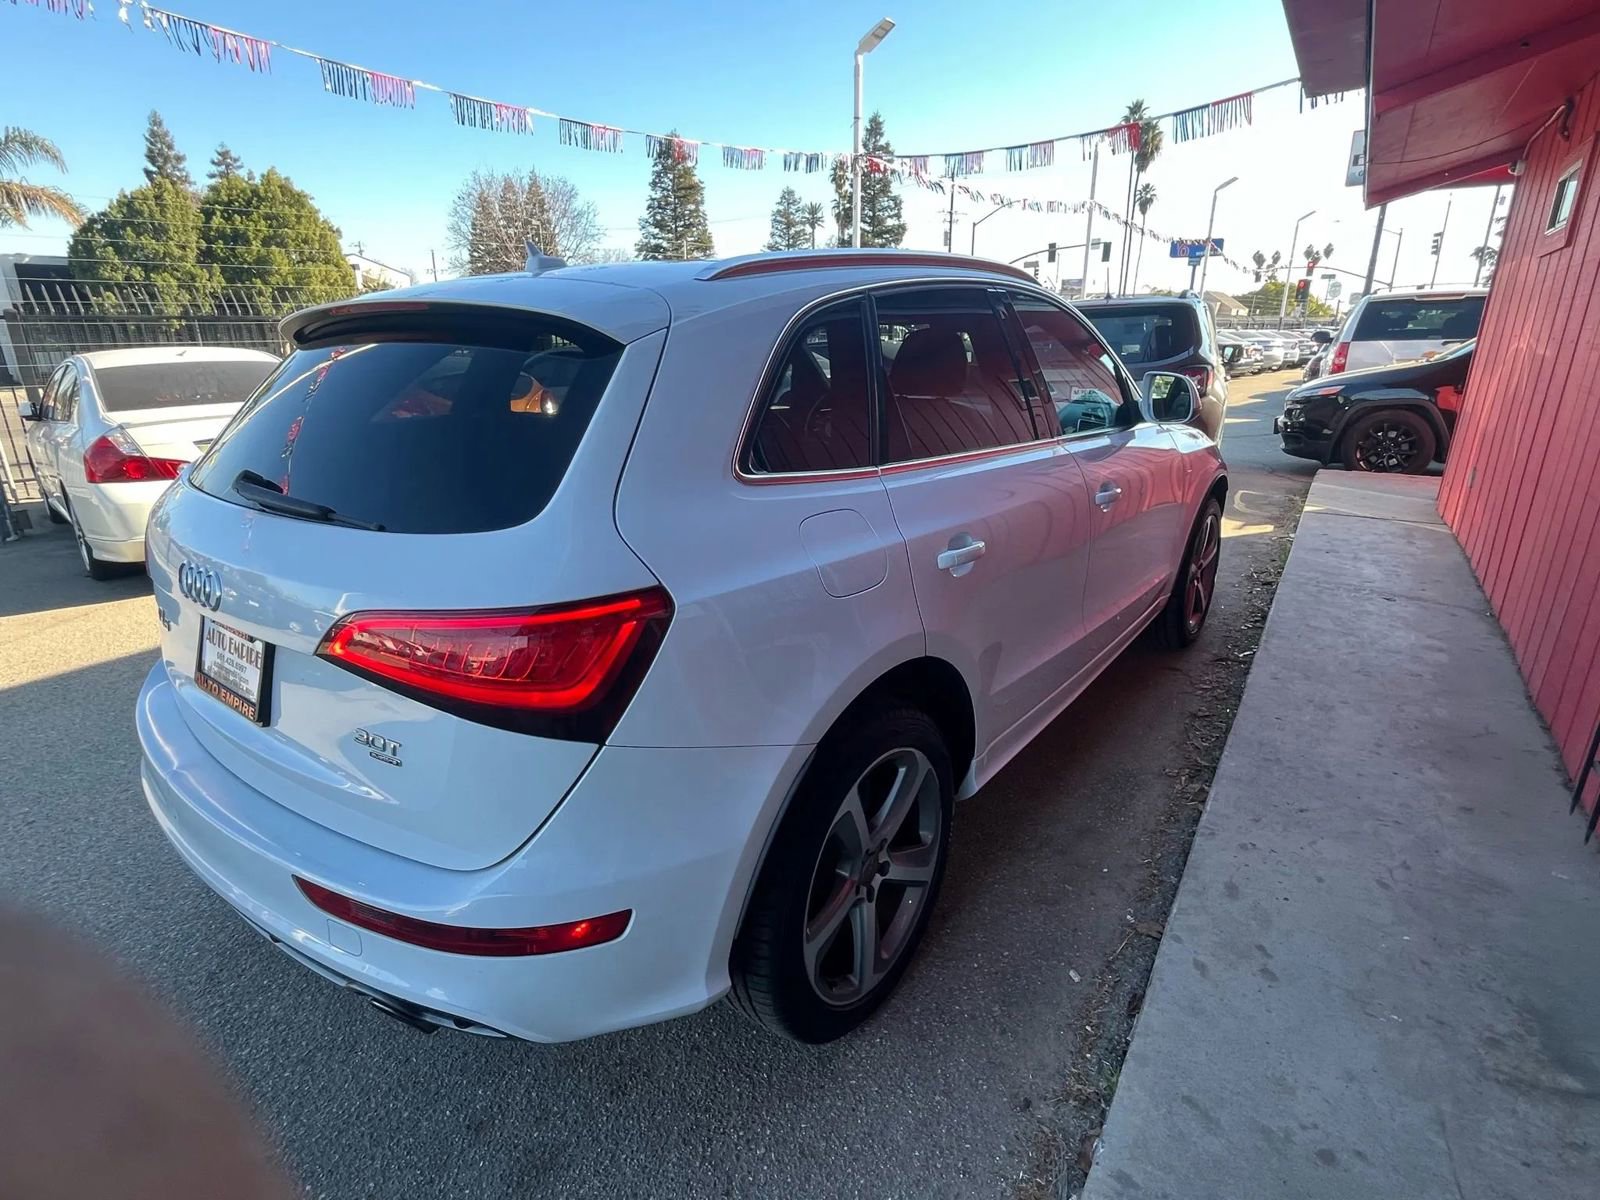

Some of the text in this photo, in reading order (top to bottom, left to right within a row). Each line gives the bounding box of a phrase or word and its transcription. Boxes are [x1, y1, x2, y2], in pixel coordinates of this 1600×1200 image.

[206, 626, 228, 650] AUTO
[228, 638, 262, 670] EMPIRE
[197, 674, 219, 696] AUTO
[220, 688, 256, 720] EMPIRE
